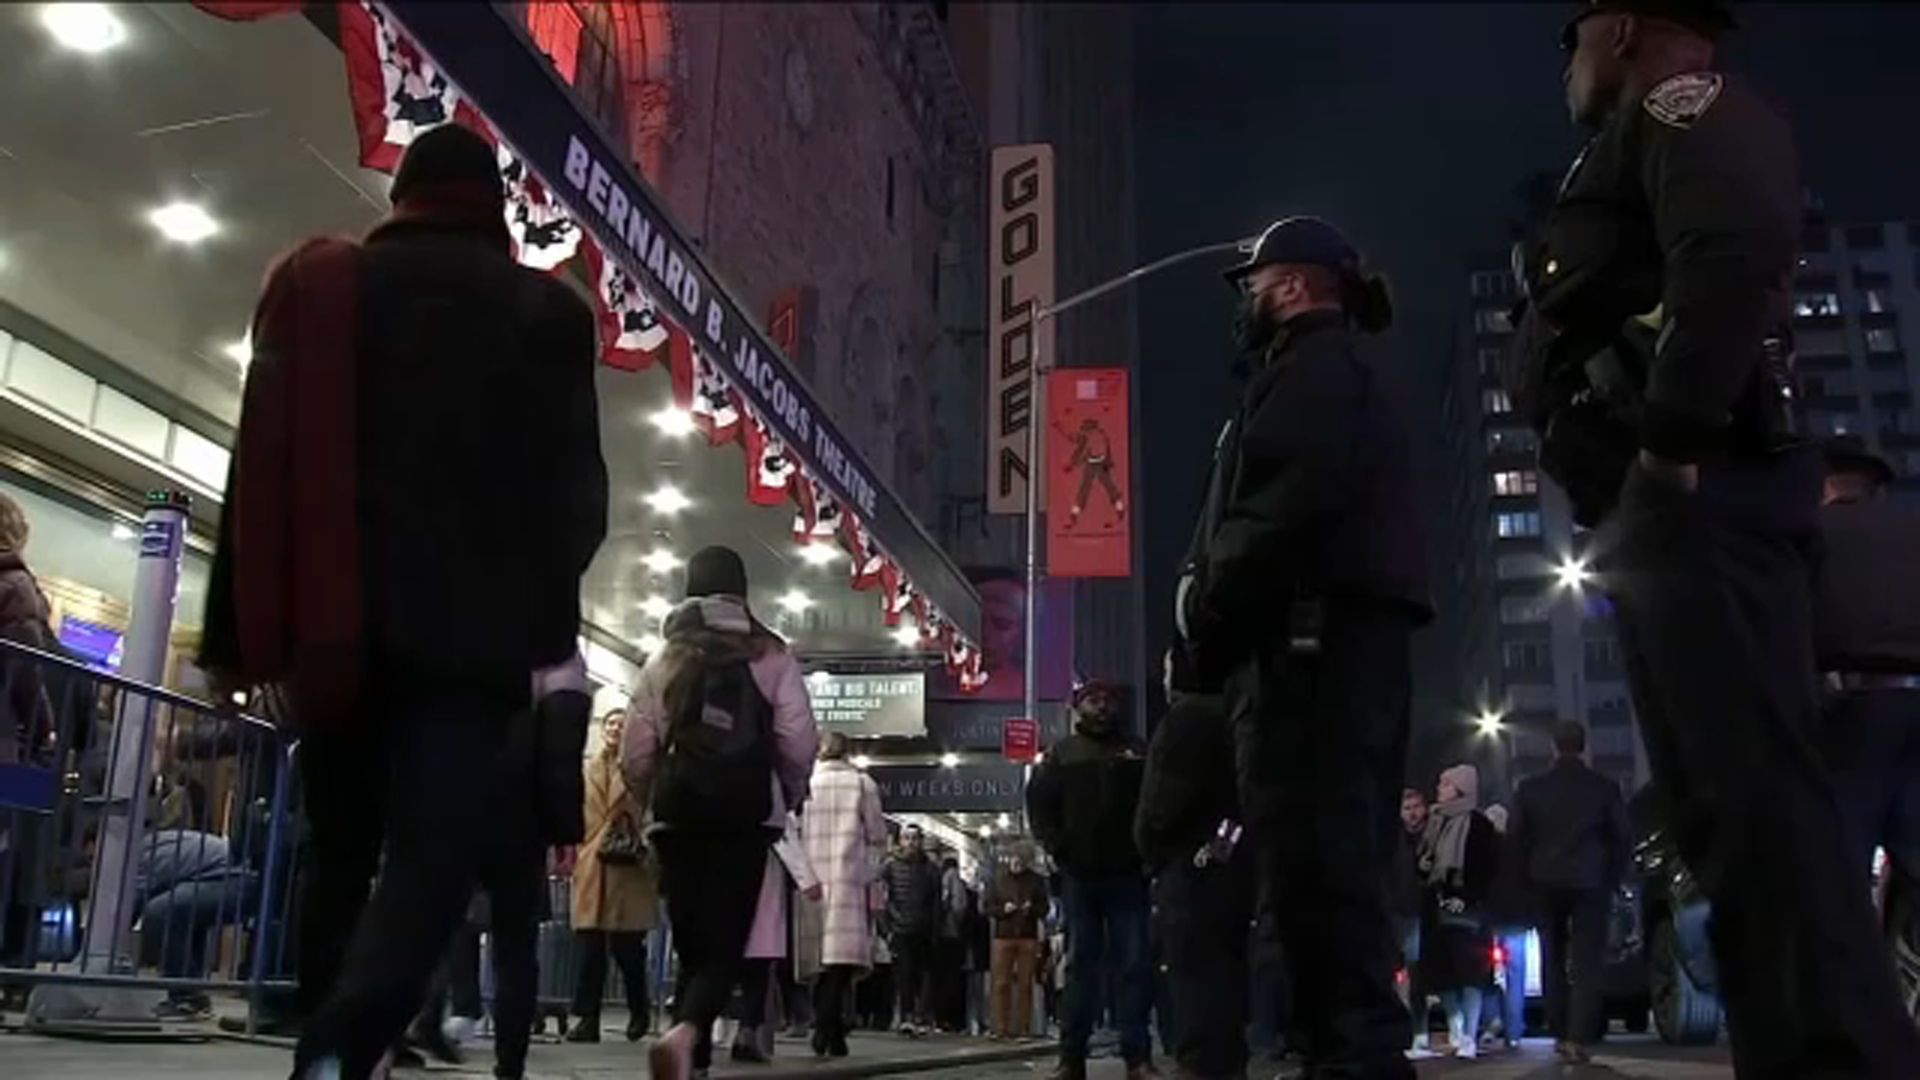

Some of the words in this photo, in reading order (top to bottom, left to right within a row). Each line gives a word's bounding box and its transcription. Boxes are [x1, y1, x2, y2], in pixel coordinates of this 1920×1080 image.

[564, 135, 700, 315] BERNARD
[706, 299, 727, 351] B.
[734, 336, 811, 442] JACOBS
[814, 424, 876, 518] THEATRE
[1001, 156, 1039, 499] GOLDEN
[901, 779, 966, 797] WEEKS
[970, 778, 1019, 797] ONLY
